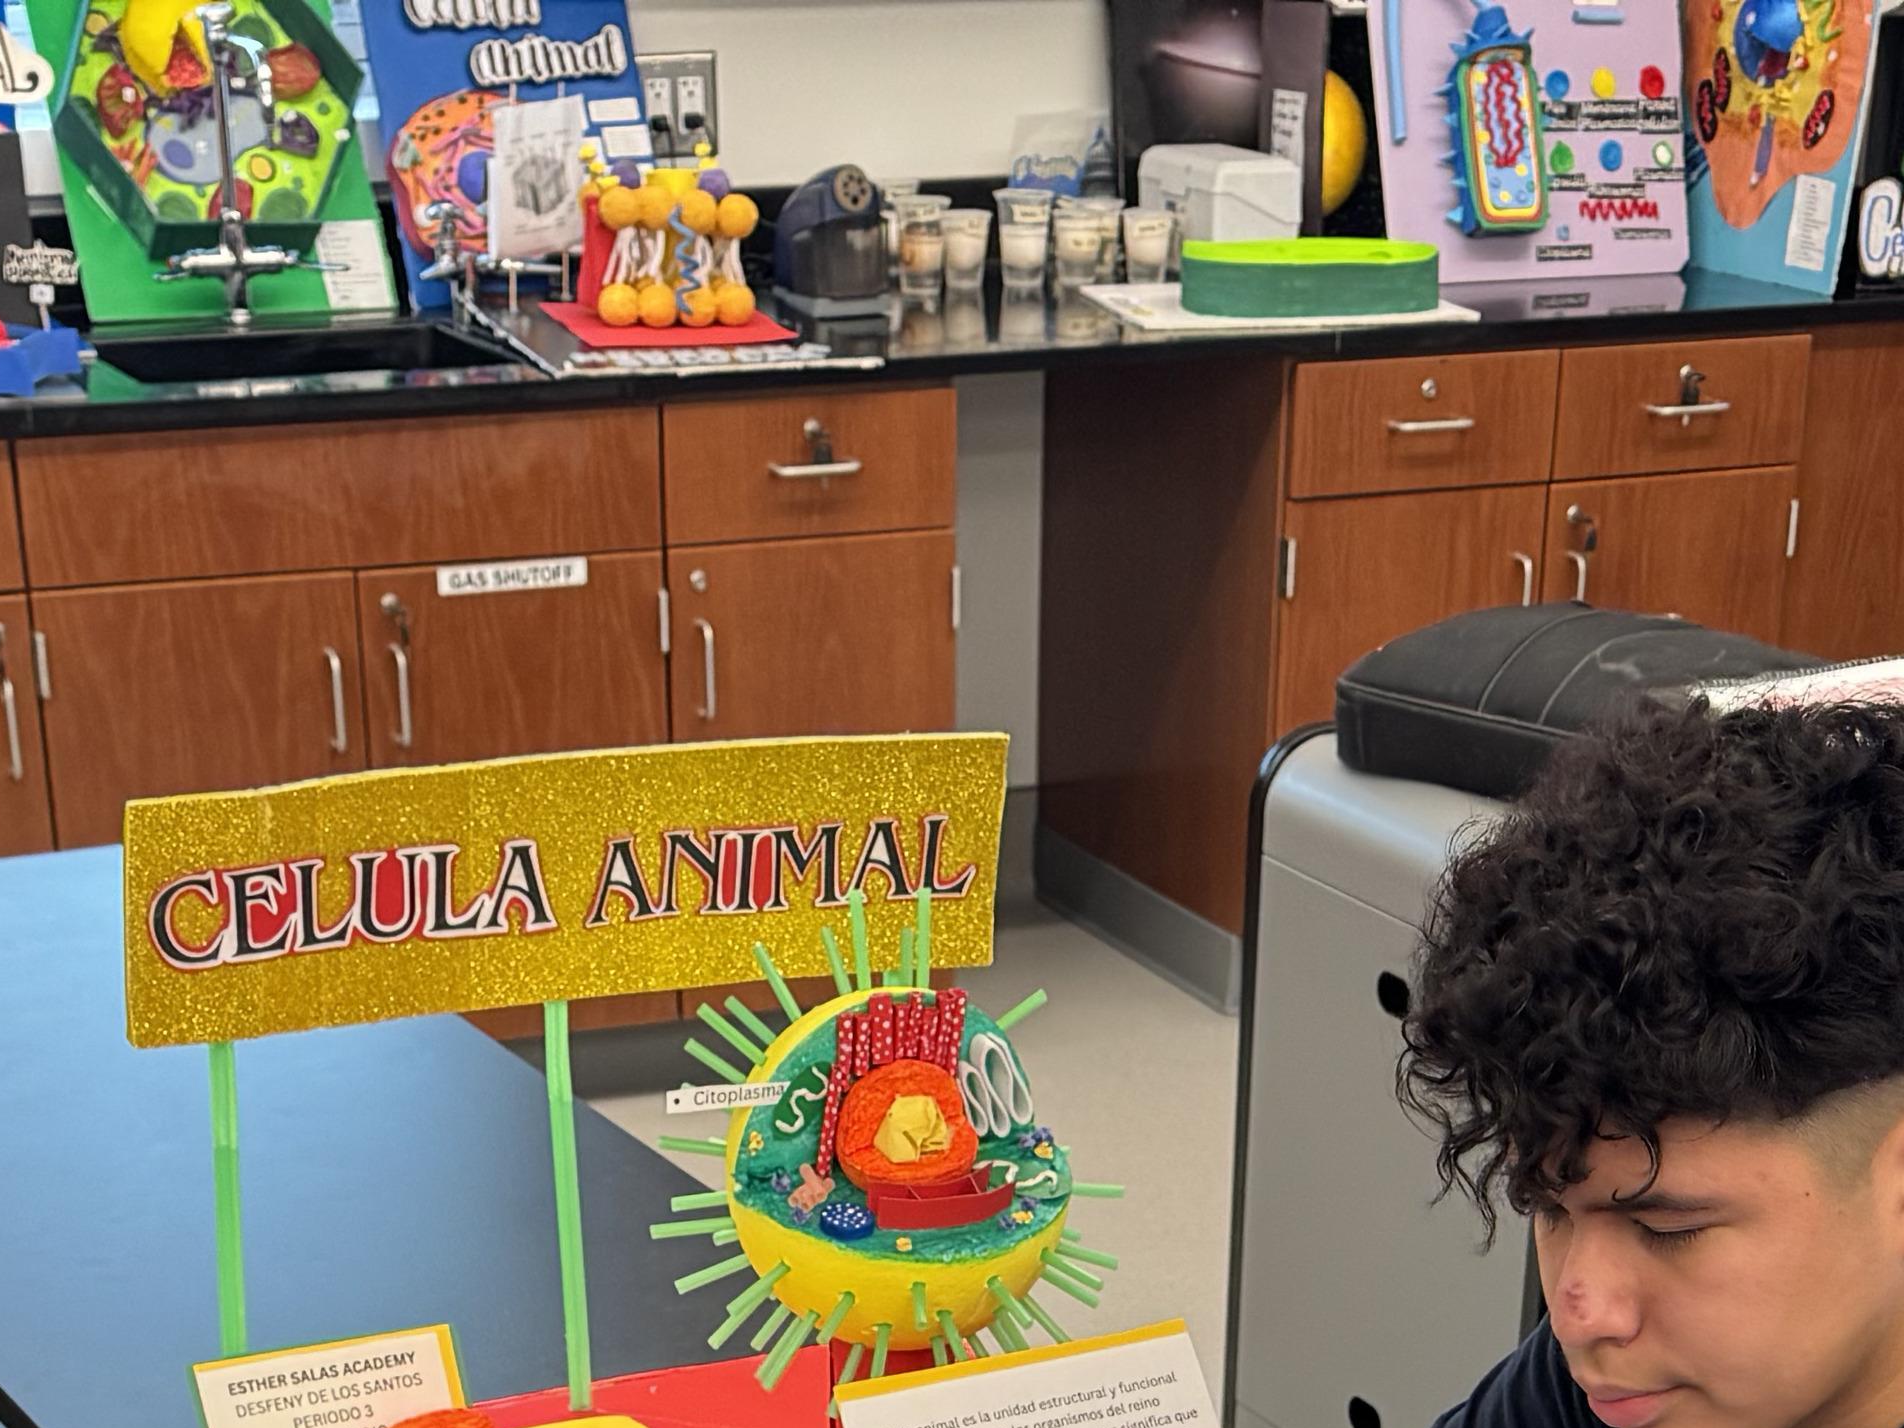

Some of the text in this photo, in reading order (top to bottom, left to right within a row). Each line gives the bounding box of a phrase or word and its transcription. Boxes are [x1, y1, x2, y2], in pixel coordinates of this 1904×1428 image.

[448, 565, 572, 589] GAS SHUTOFF
[149, 815, 976, 969] CELULA ANIMAL
[693, 1084, 785, 1106] Citoplasma
[228, 1350, 417, 1397] ESTHER SALAS ACADEMY
[236, 1371, 424, 1419] DESFENY DE LOS SANTOS
[961, 1415, 978, 1427] es
[977, 1411, 992, 1423] la
[992, 1400, 1037, 1421] unidad
[1038, 1385, 1108, 1411] estructural
[1108, 1387, 1116, 1400] y
[1118, 1370, 1178, 1394] funcional
[1105, 1402, 1127, 1417] del
[1128, 1397, 1161, 1413] reino
[364, 1405, 375, 1419] 3
[1174, 1408, 1198, 1425] que
